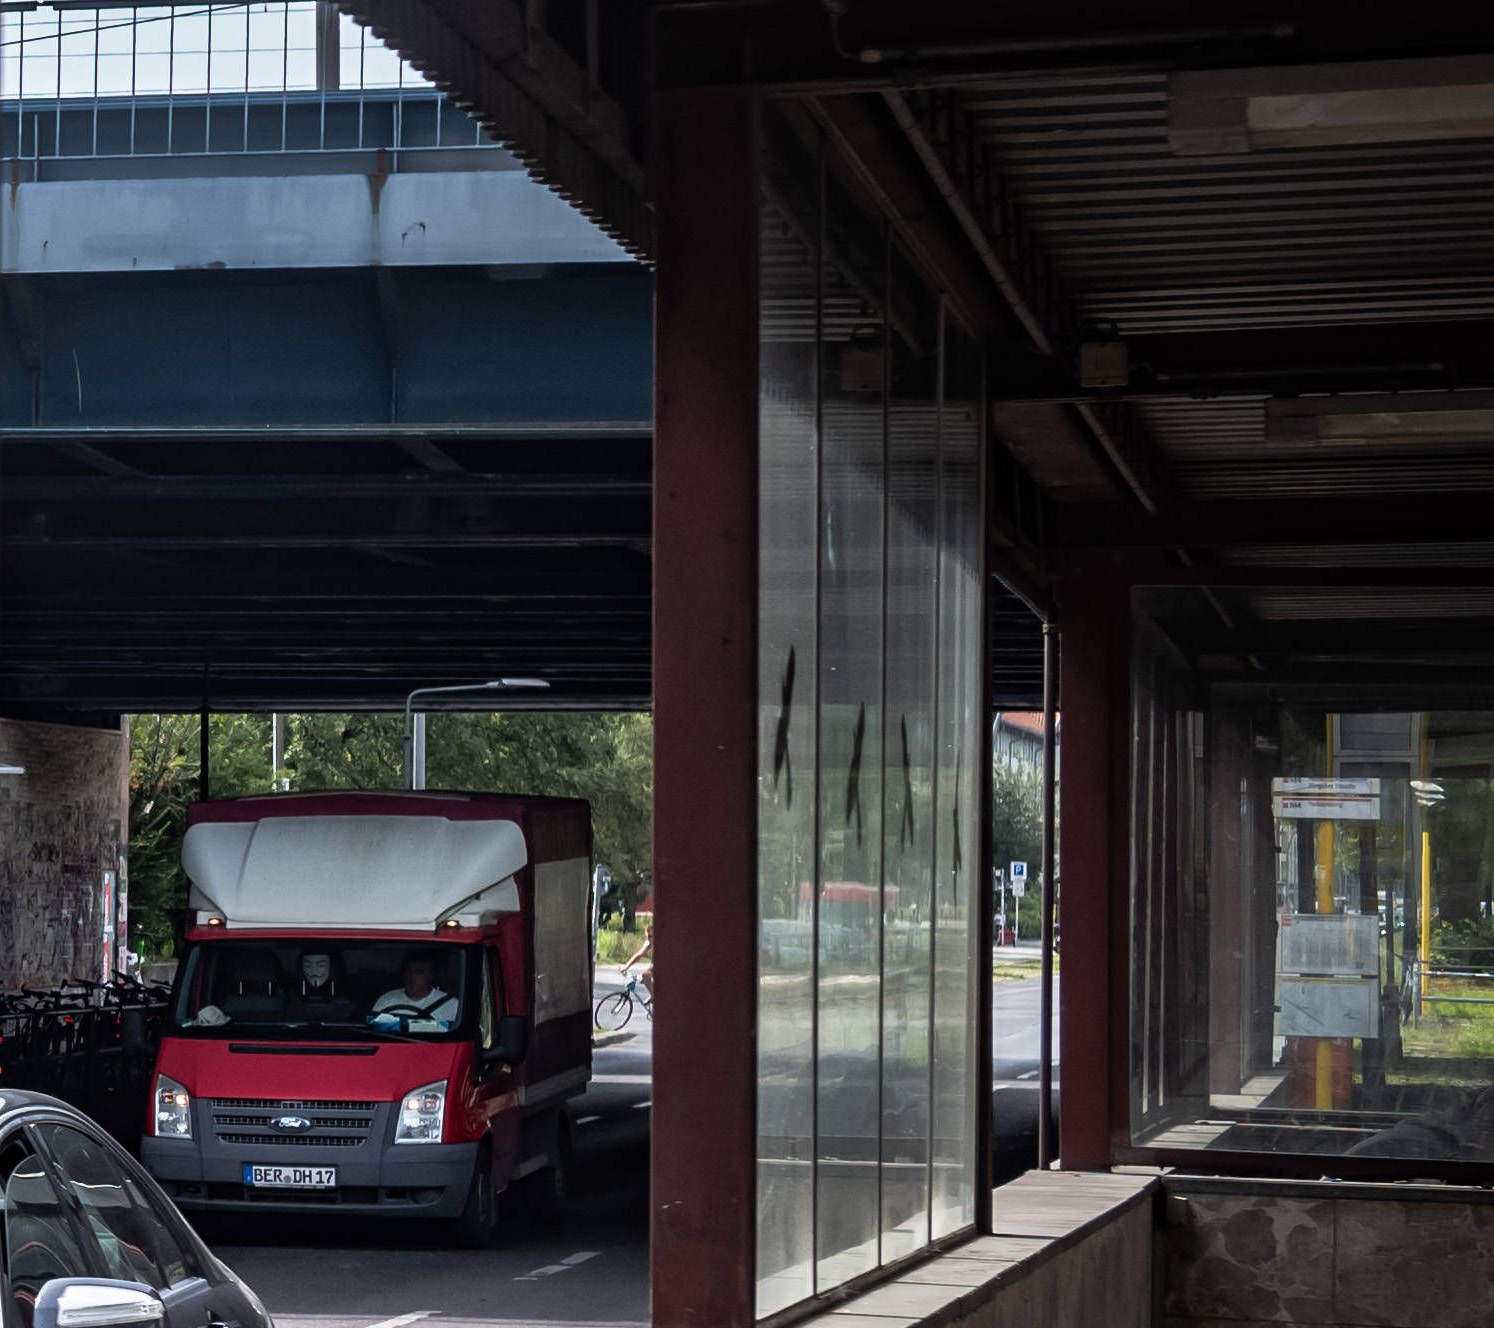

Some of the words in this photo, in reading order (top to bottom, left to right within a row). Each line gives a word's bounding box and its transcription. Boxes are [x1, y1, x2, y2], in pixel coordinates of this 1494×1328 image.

[254, 1168, 282, 1183] BER
[293, 1169, 312, 1183] DH
[315, 1170, 333, 1184] 17
